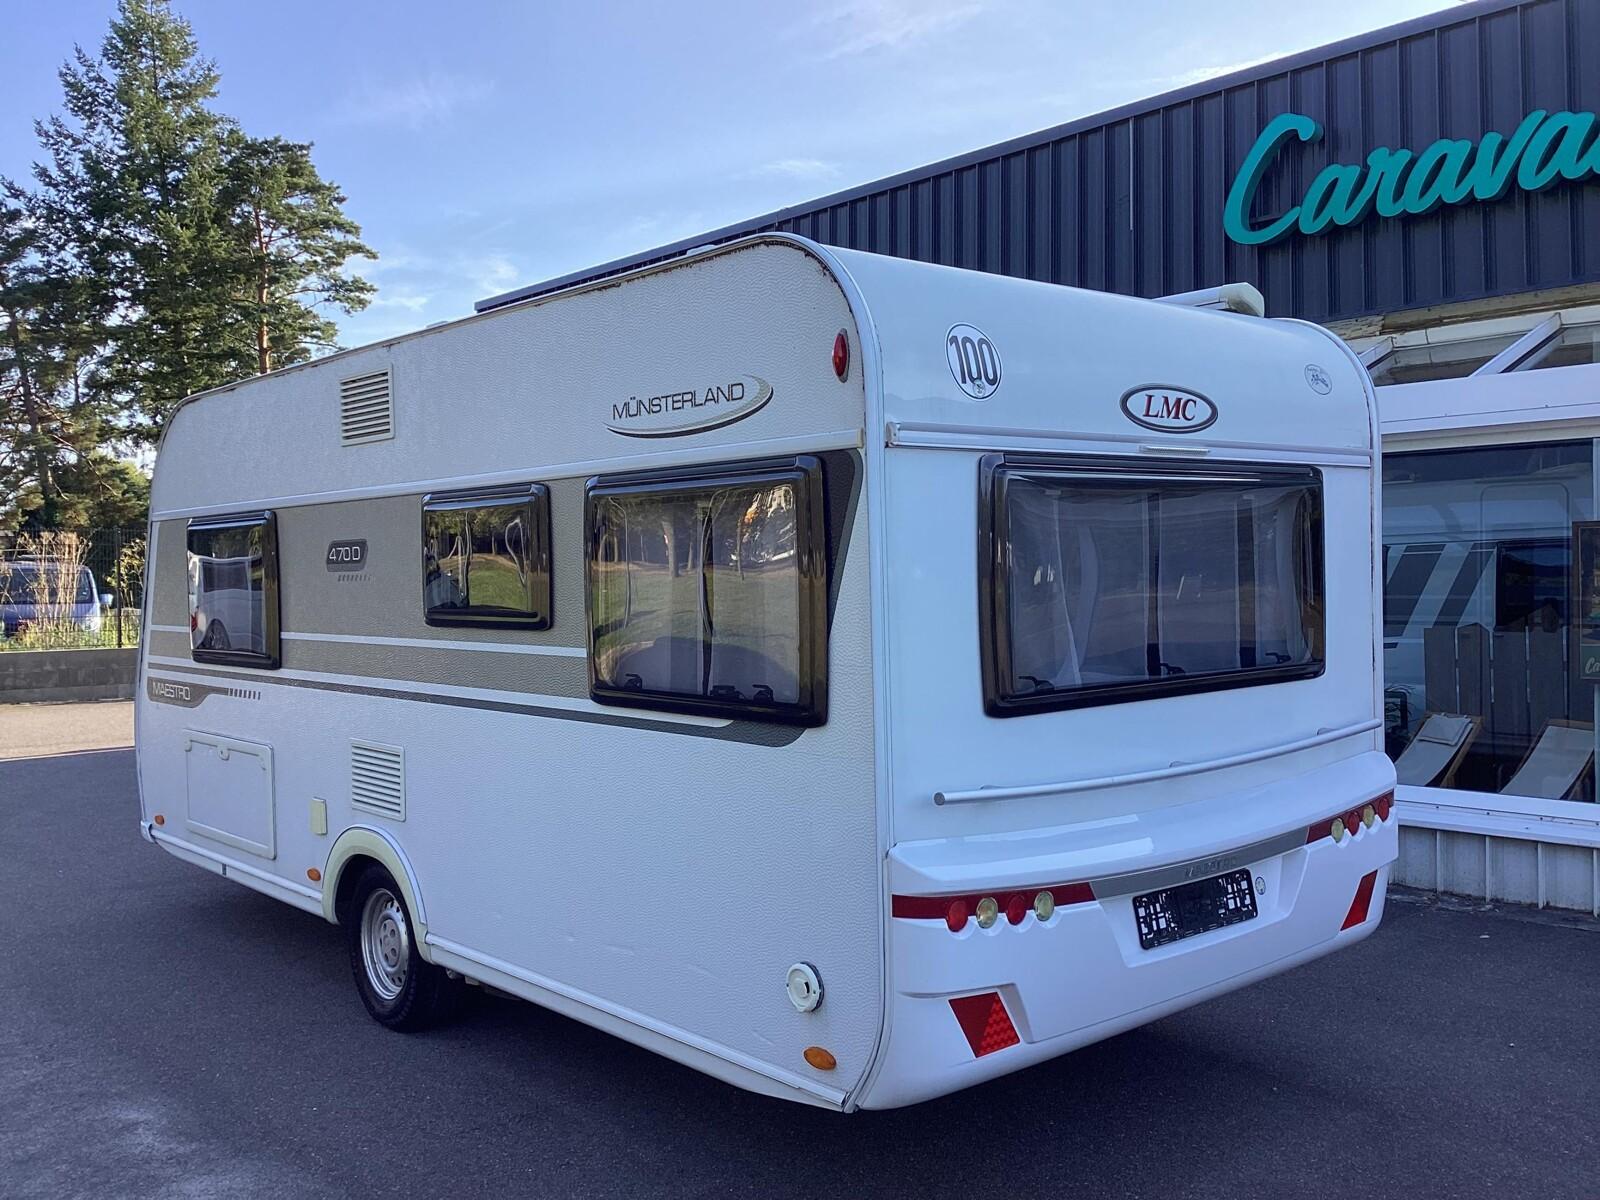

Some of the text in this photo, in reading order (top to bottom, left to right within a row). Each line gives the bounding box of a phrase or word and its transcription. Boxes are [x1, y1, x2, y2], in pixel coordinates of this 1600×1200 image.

[1223, 109, 1600, 245] Carava
[948, 335, 998, 386] 100
[612, 382, 745, 421] MÜNSTERLAND
[1142, 393, 1197, 421] LMC
[152, 681, 191, 701] MAESTRO
